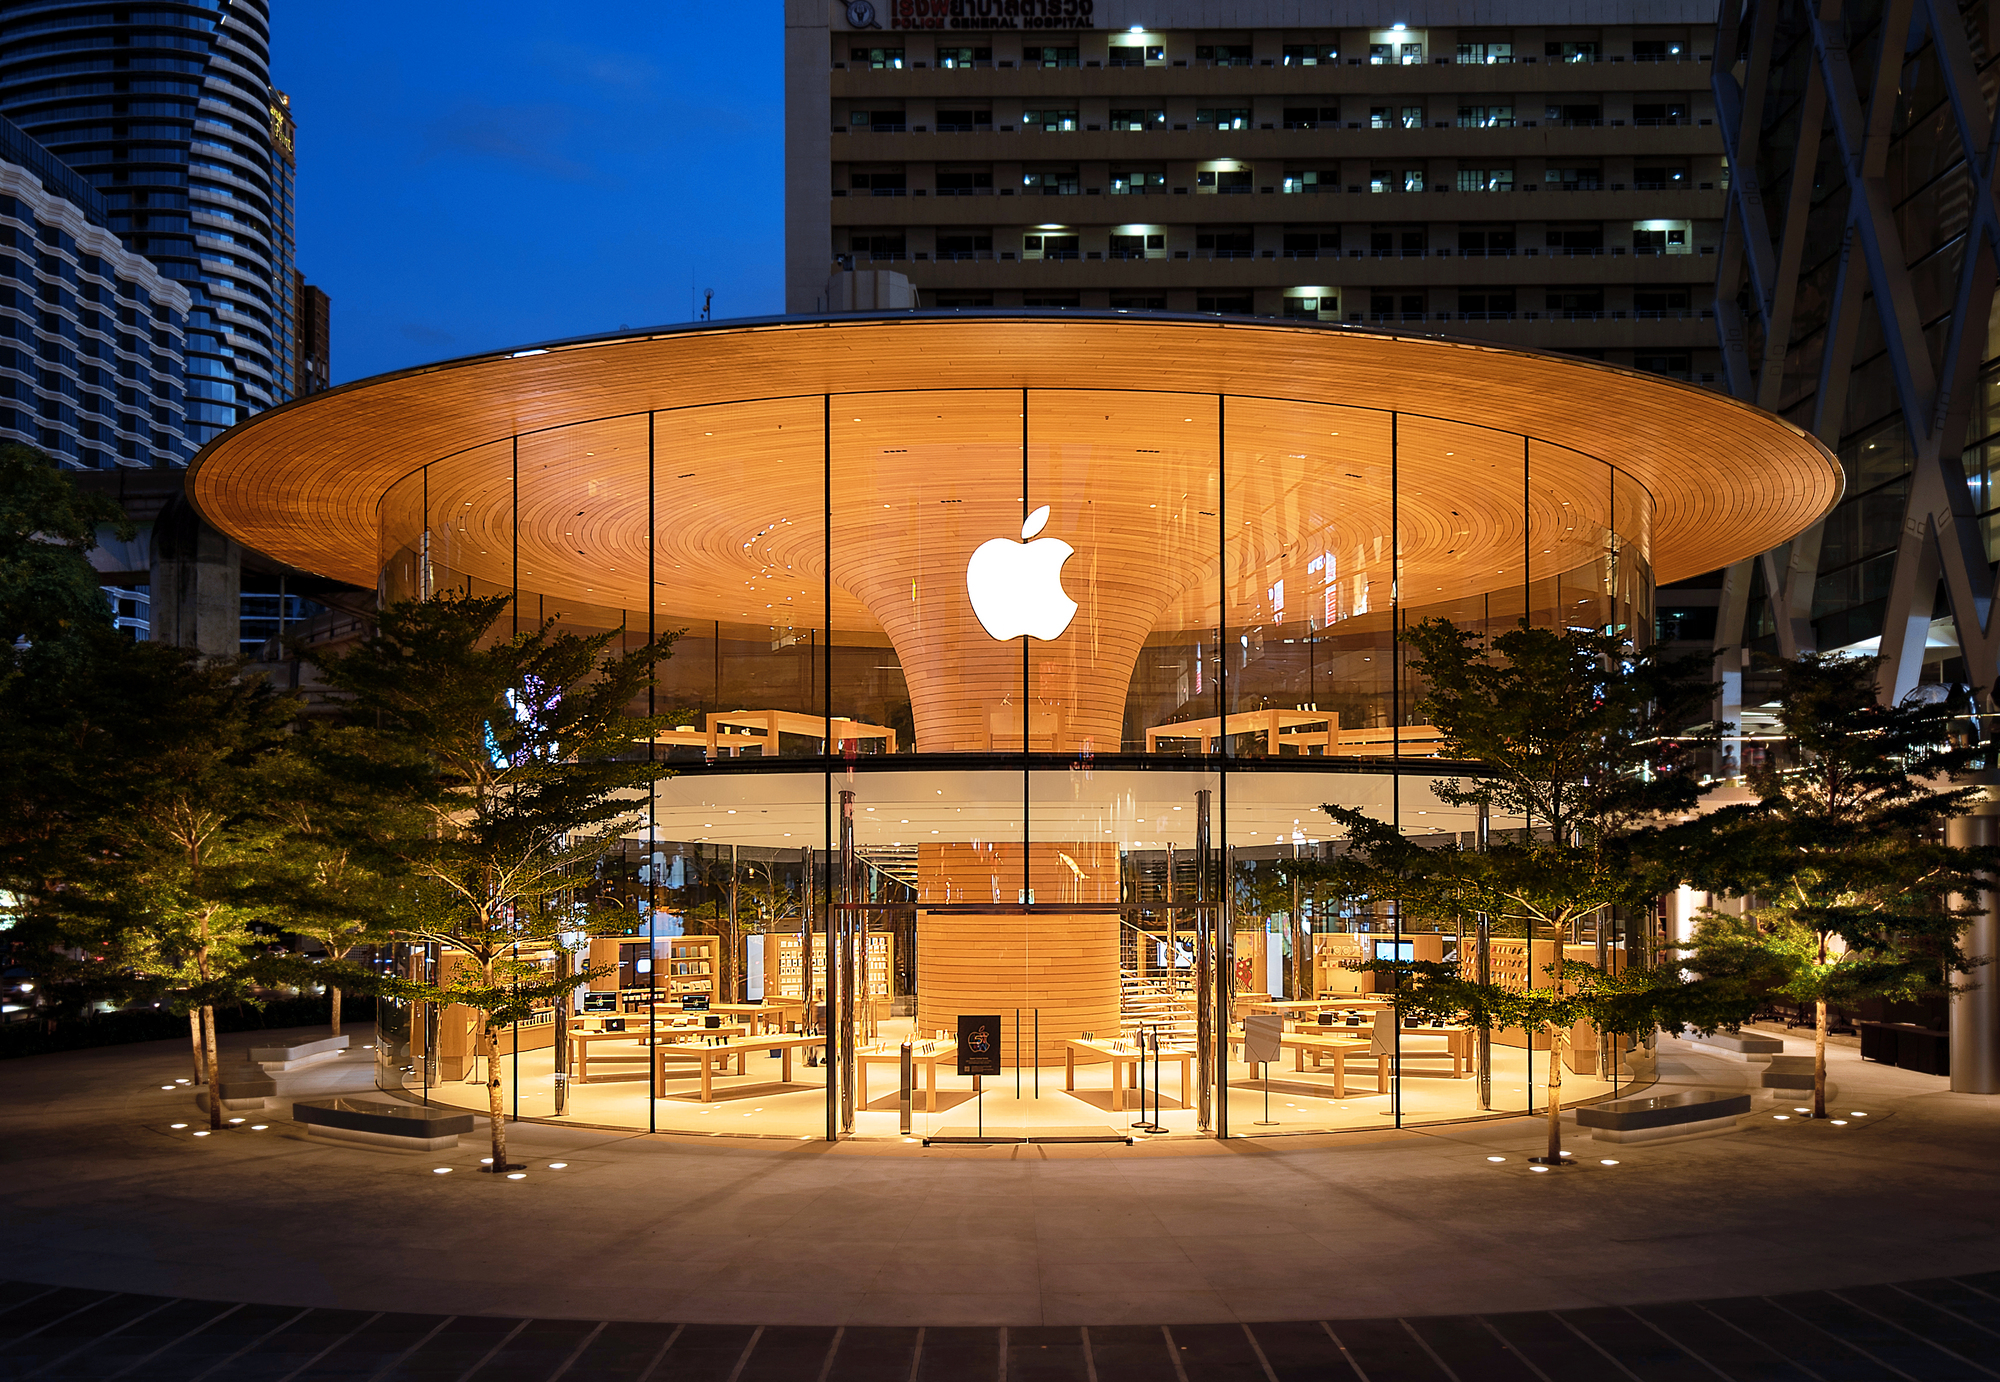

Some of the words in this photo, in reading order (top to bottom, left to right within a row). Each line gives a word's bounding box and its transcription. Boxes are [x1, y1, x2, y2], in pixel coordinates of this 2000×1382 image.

[891, 17, 945, 29] POLICE
[950, 17, 1018, 29] GENERAL
[1023, 17, 1094, 28] HOSPITAL
